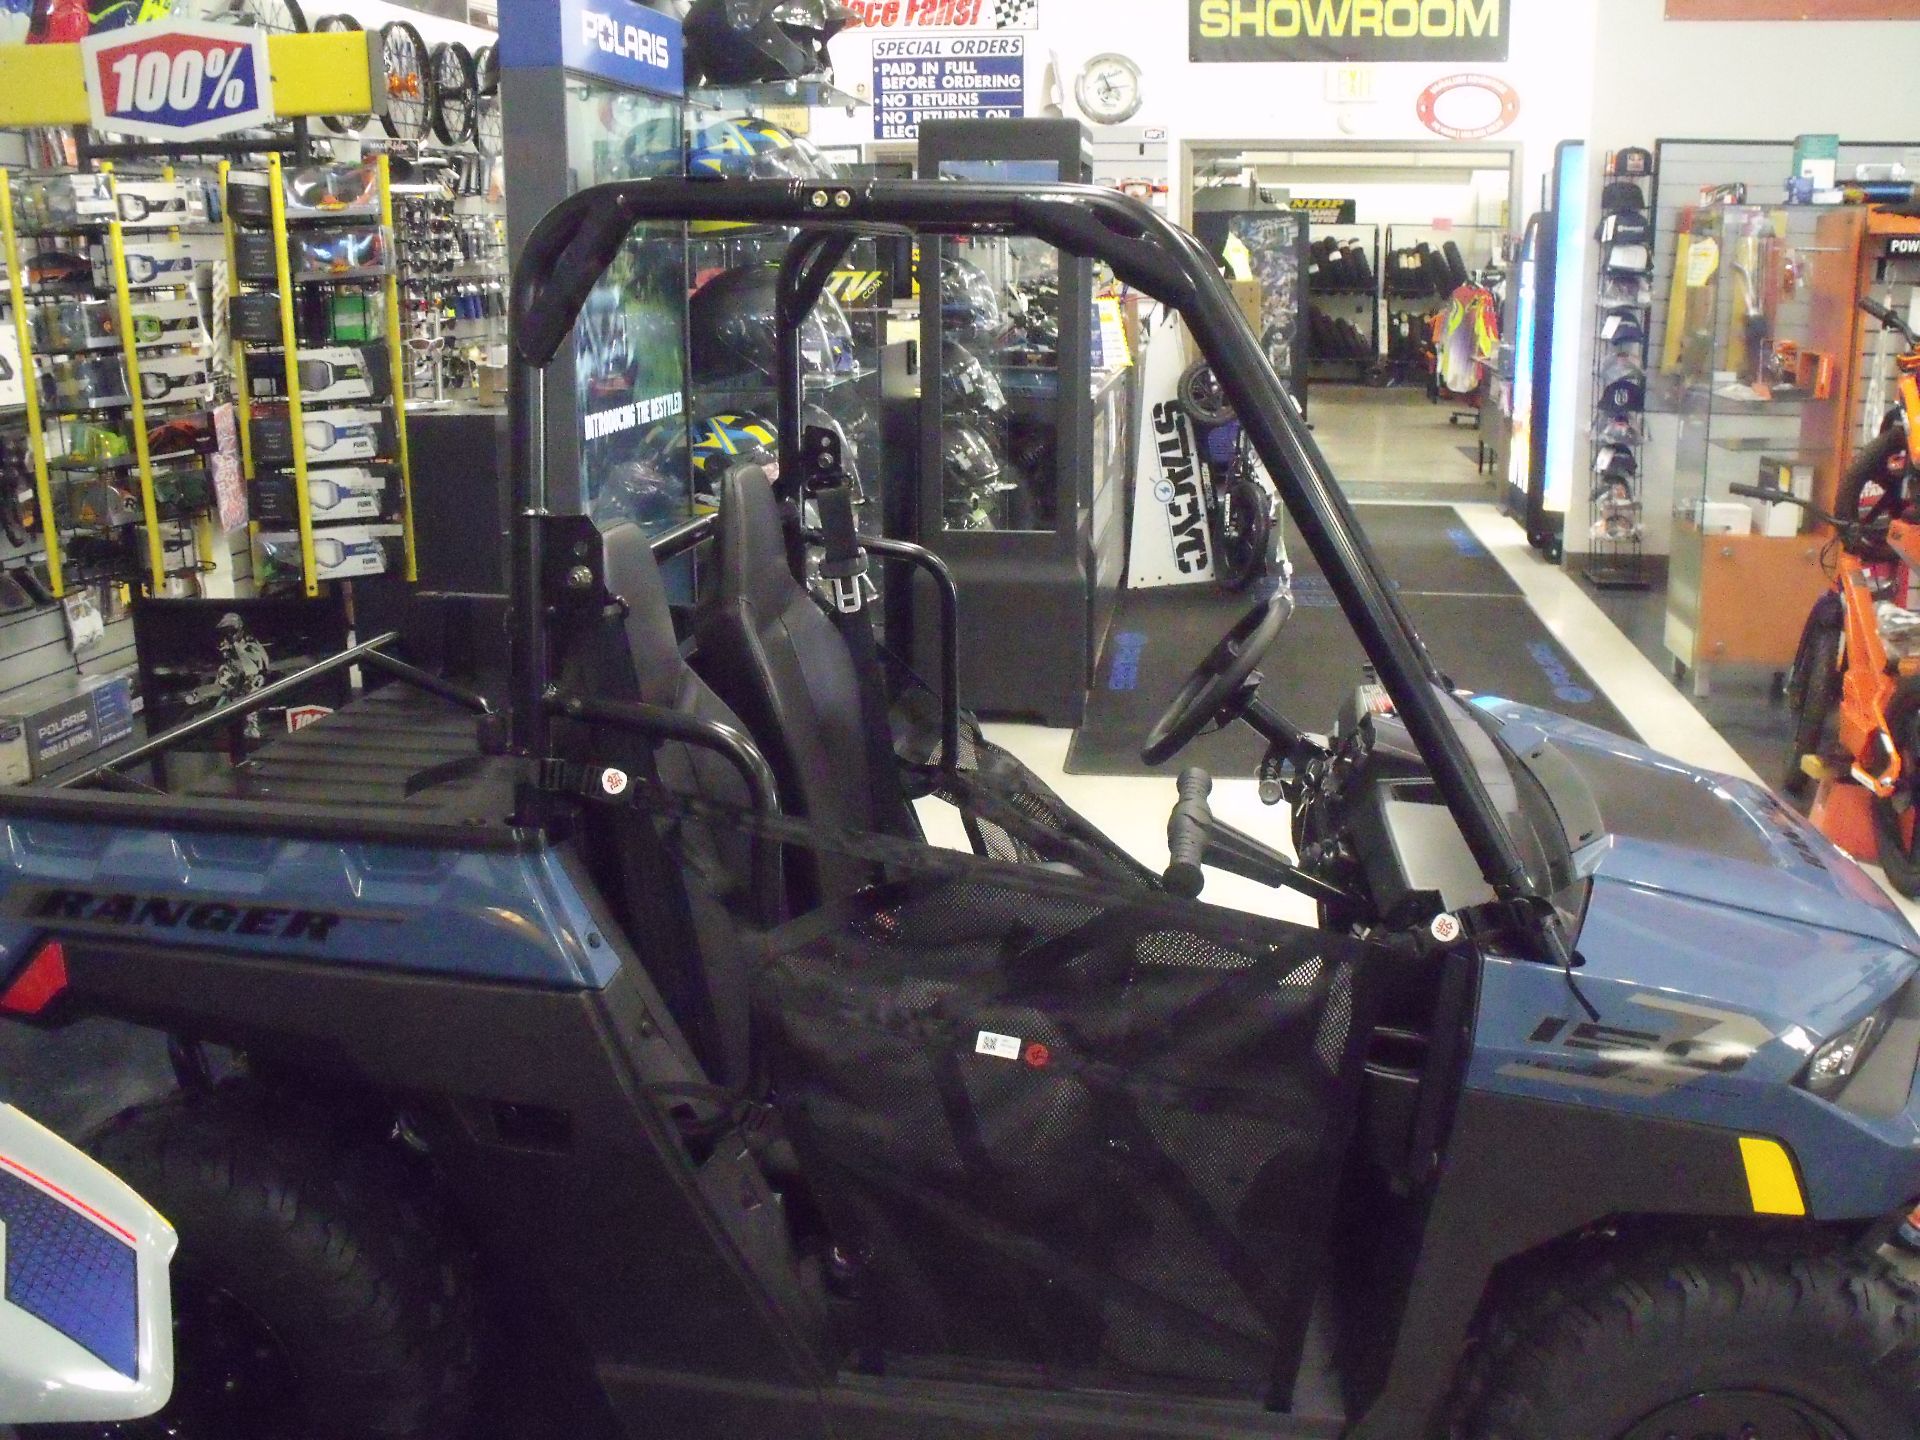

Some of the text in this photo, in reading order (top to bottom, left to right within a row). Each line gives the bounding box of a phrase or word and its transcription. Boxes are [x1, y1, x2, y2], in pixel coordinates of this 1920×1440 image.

[843, 0, 982, 27] ace Fans!
[1199, 0, 1499, 37] SHOWROOM
[582, 9, 669, 69] POLARIS
[876, 39, 1020, 56] SPECIAL ORDERS
[112, 47, 245, 113] 100%
[881, 74, 1021, 90] BEFORE ORDERING
[882, 61, 977, 76] PAID IN FULL
[882, 92, 979, 107] NO RETURNS
[882, 111, 907, 124] NO
[636, 399, 651, 425] THE
[1153, 400, 1207, 574] STACYC
[38, 709, 88, 739] POLARIS
[36, 889, 340, 943] RANGER
